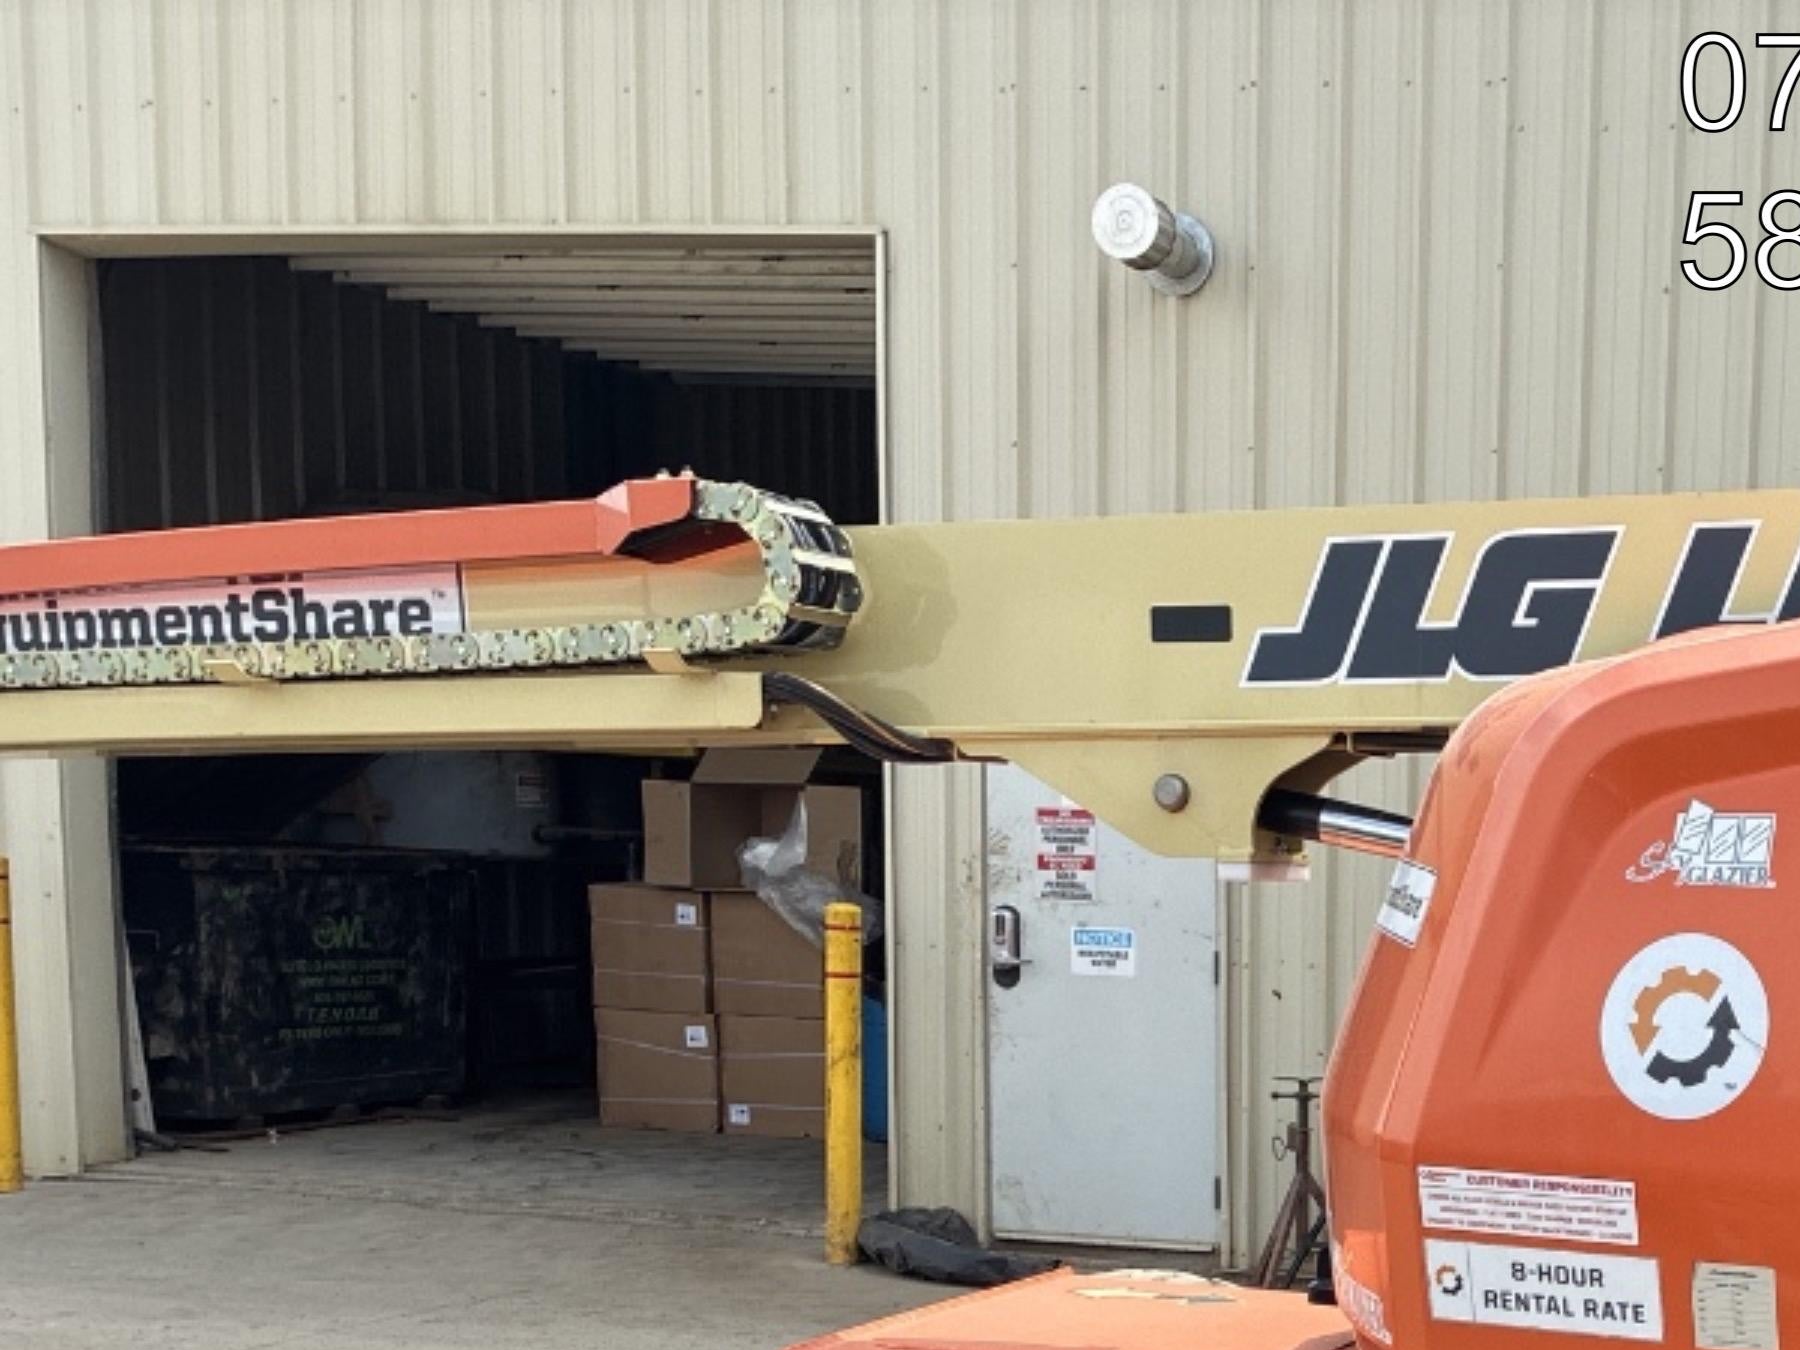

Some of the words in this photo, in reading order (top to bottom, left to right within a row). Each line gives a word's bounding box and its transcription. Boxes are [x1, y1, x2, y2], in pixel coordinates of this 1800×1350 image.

[1240, 524, 1625, 688] JLG
[1511, 1262, 1604, 1288] 8-HOUR
[1483, 1290, 1575, 1317] RENTAL
[1583, 1299, 1646, 1323] RATE
